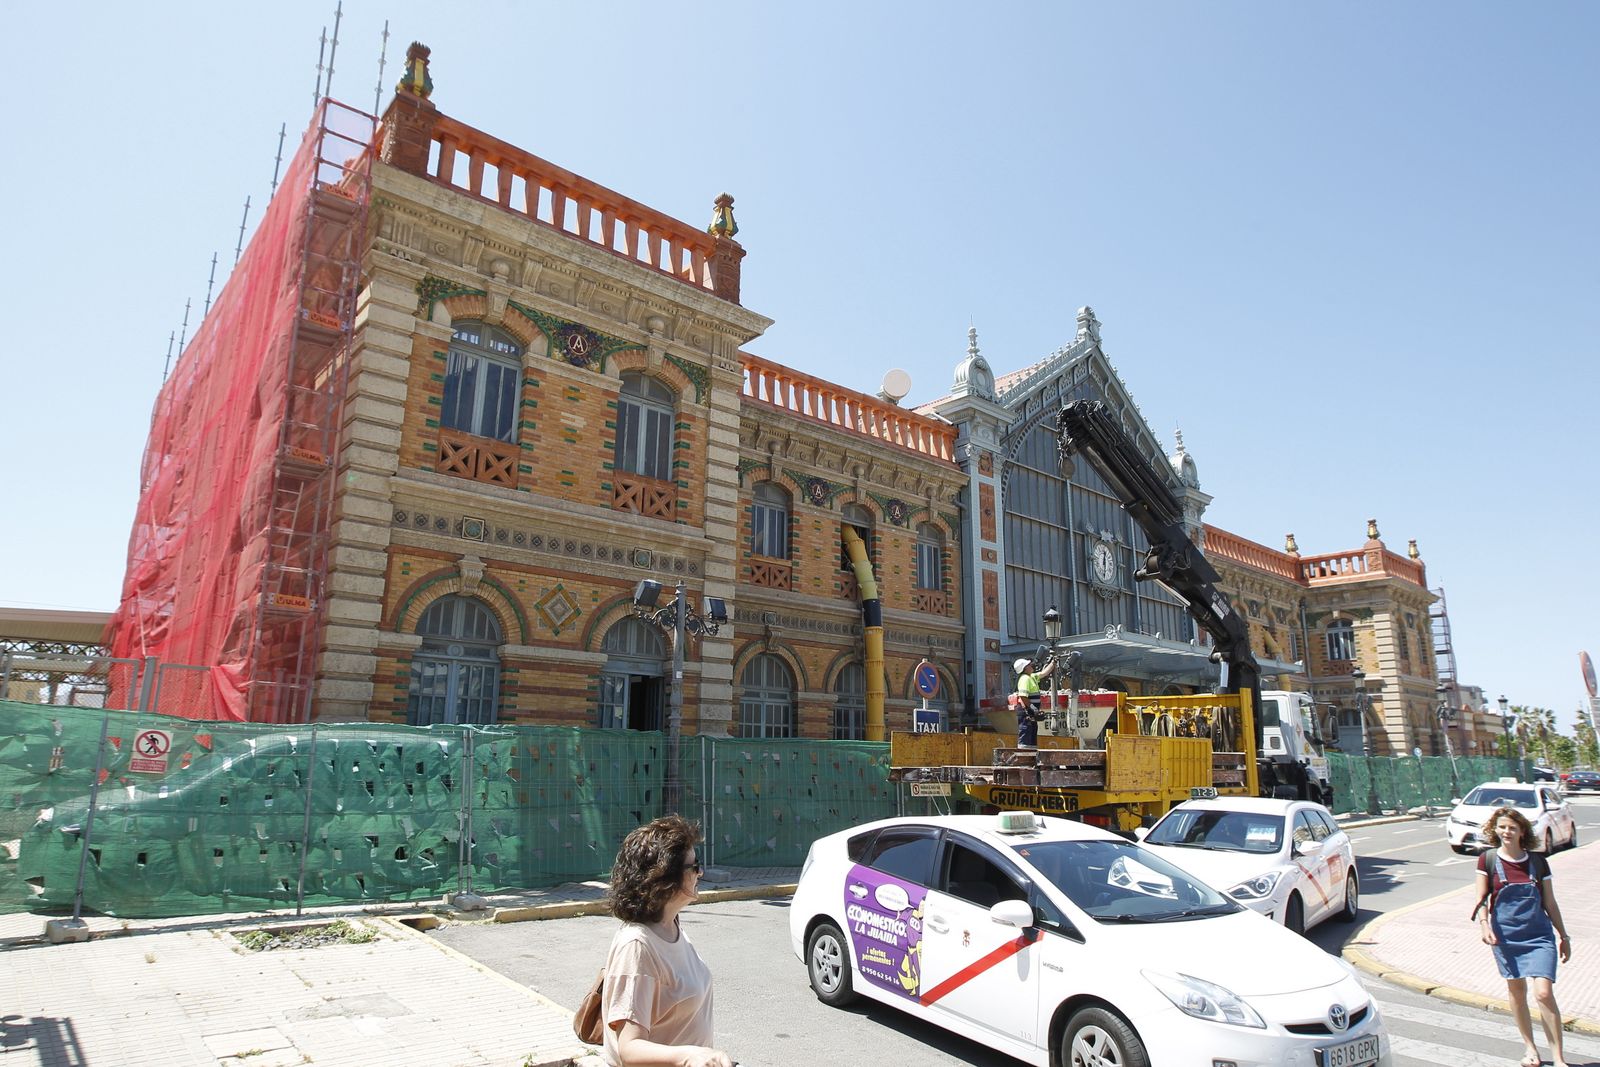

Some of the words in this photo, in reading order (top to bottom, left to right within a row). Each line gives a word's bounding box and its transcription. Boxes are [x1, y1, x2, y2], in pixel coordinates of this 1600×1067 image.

[917, 721, 939, 733] TAXI
[854, 921, 866, 935] LA
[1330, 1045, 1356, 1067] 6618
[1358, 1038, 1377, 1060] GPK
